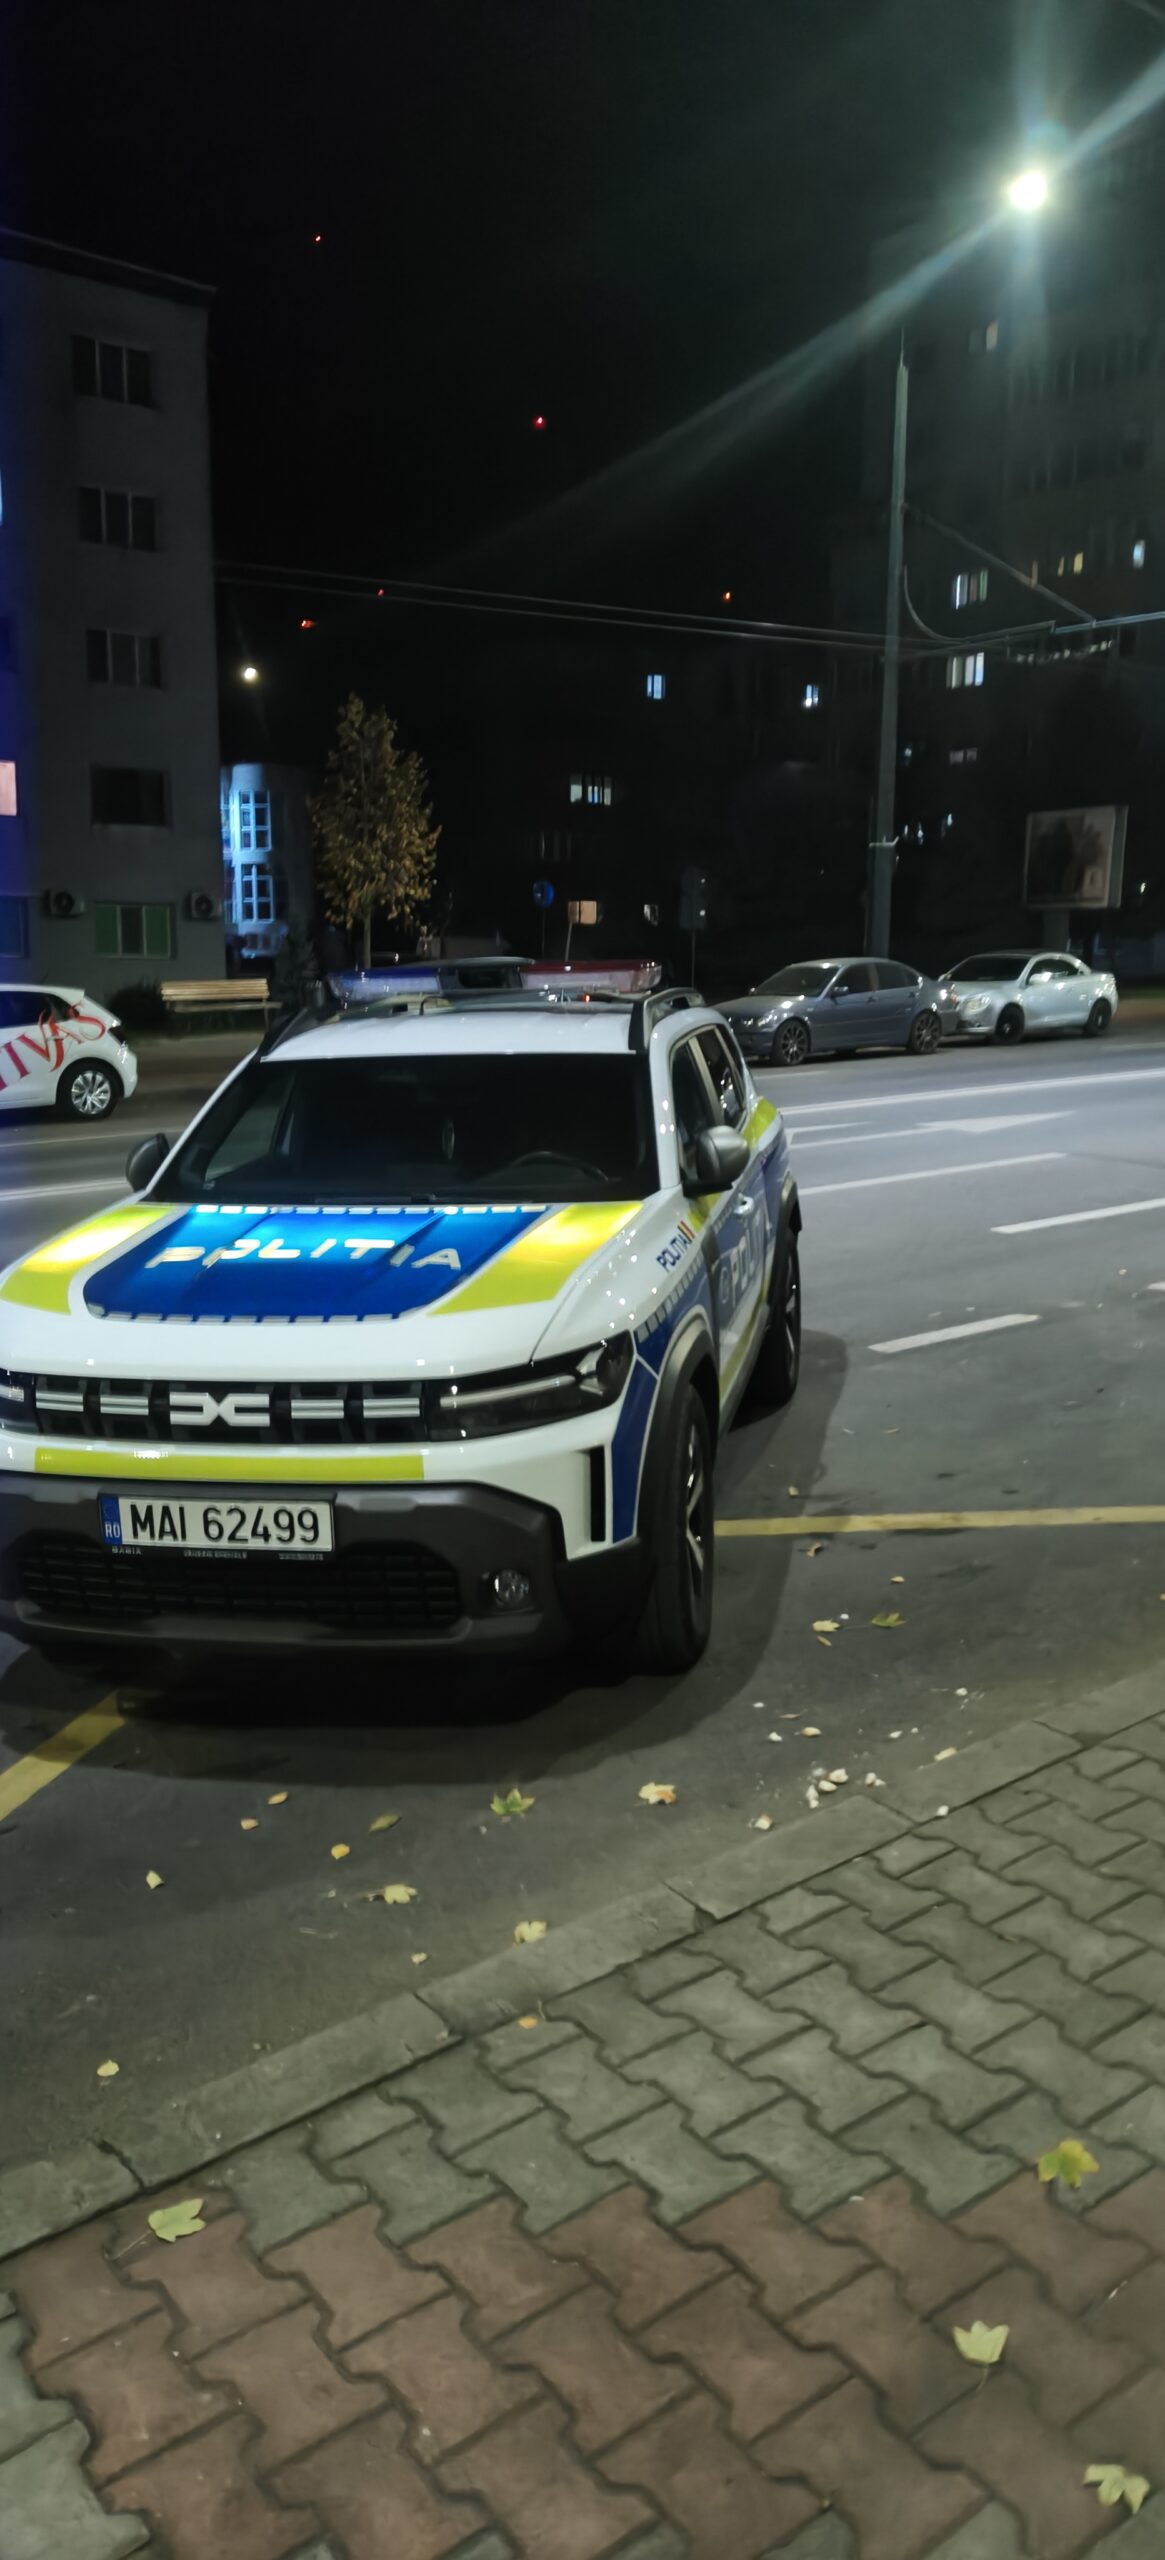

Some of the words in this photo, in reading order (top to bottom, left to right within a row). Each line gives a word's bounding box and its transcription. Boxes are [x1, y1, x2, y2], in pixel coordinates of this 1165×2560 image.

[0, 1001, 106, 1091] IVAS
[105, 1522, 121, 1539] RO
[131, 1503, 187, 1541] MAI
[202, 1507, 320, 1543] 62499
